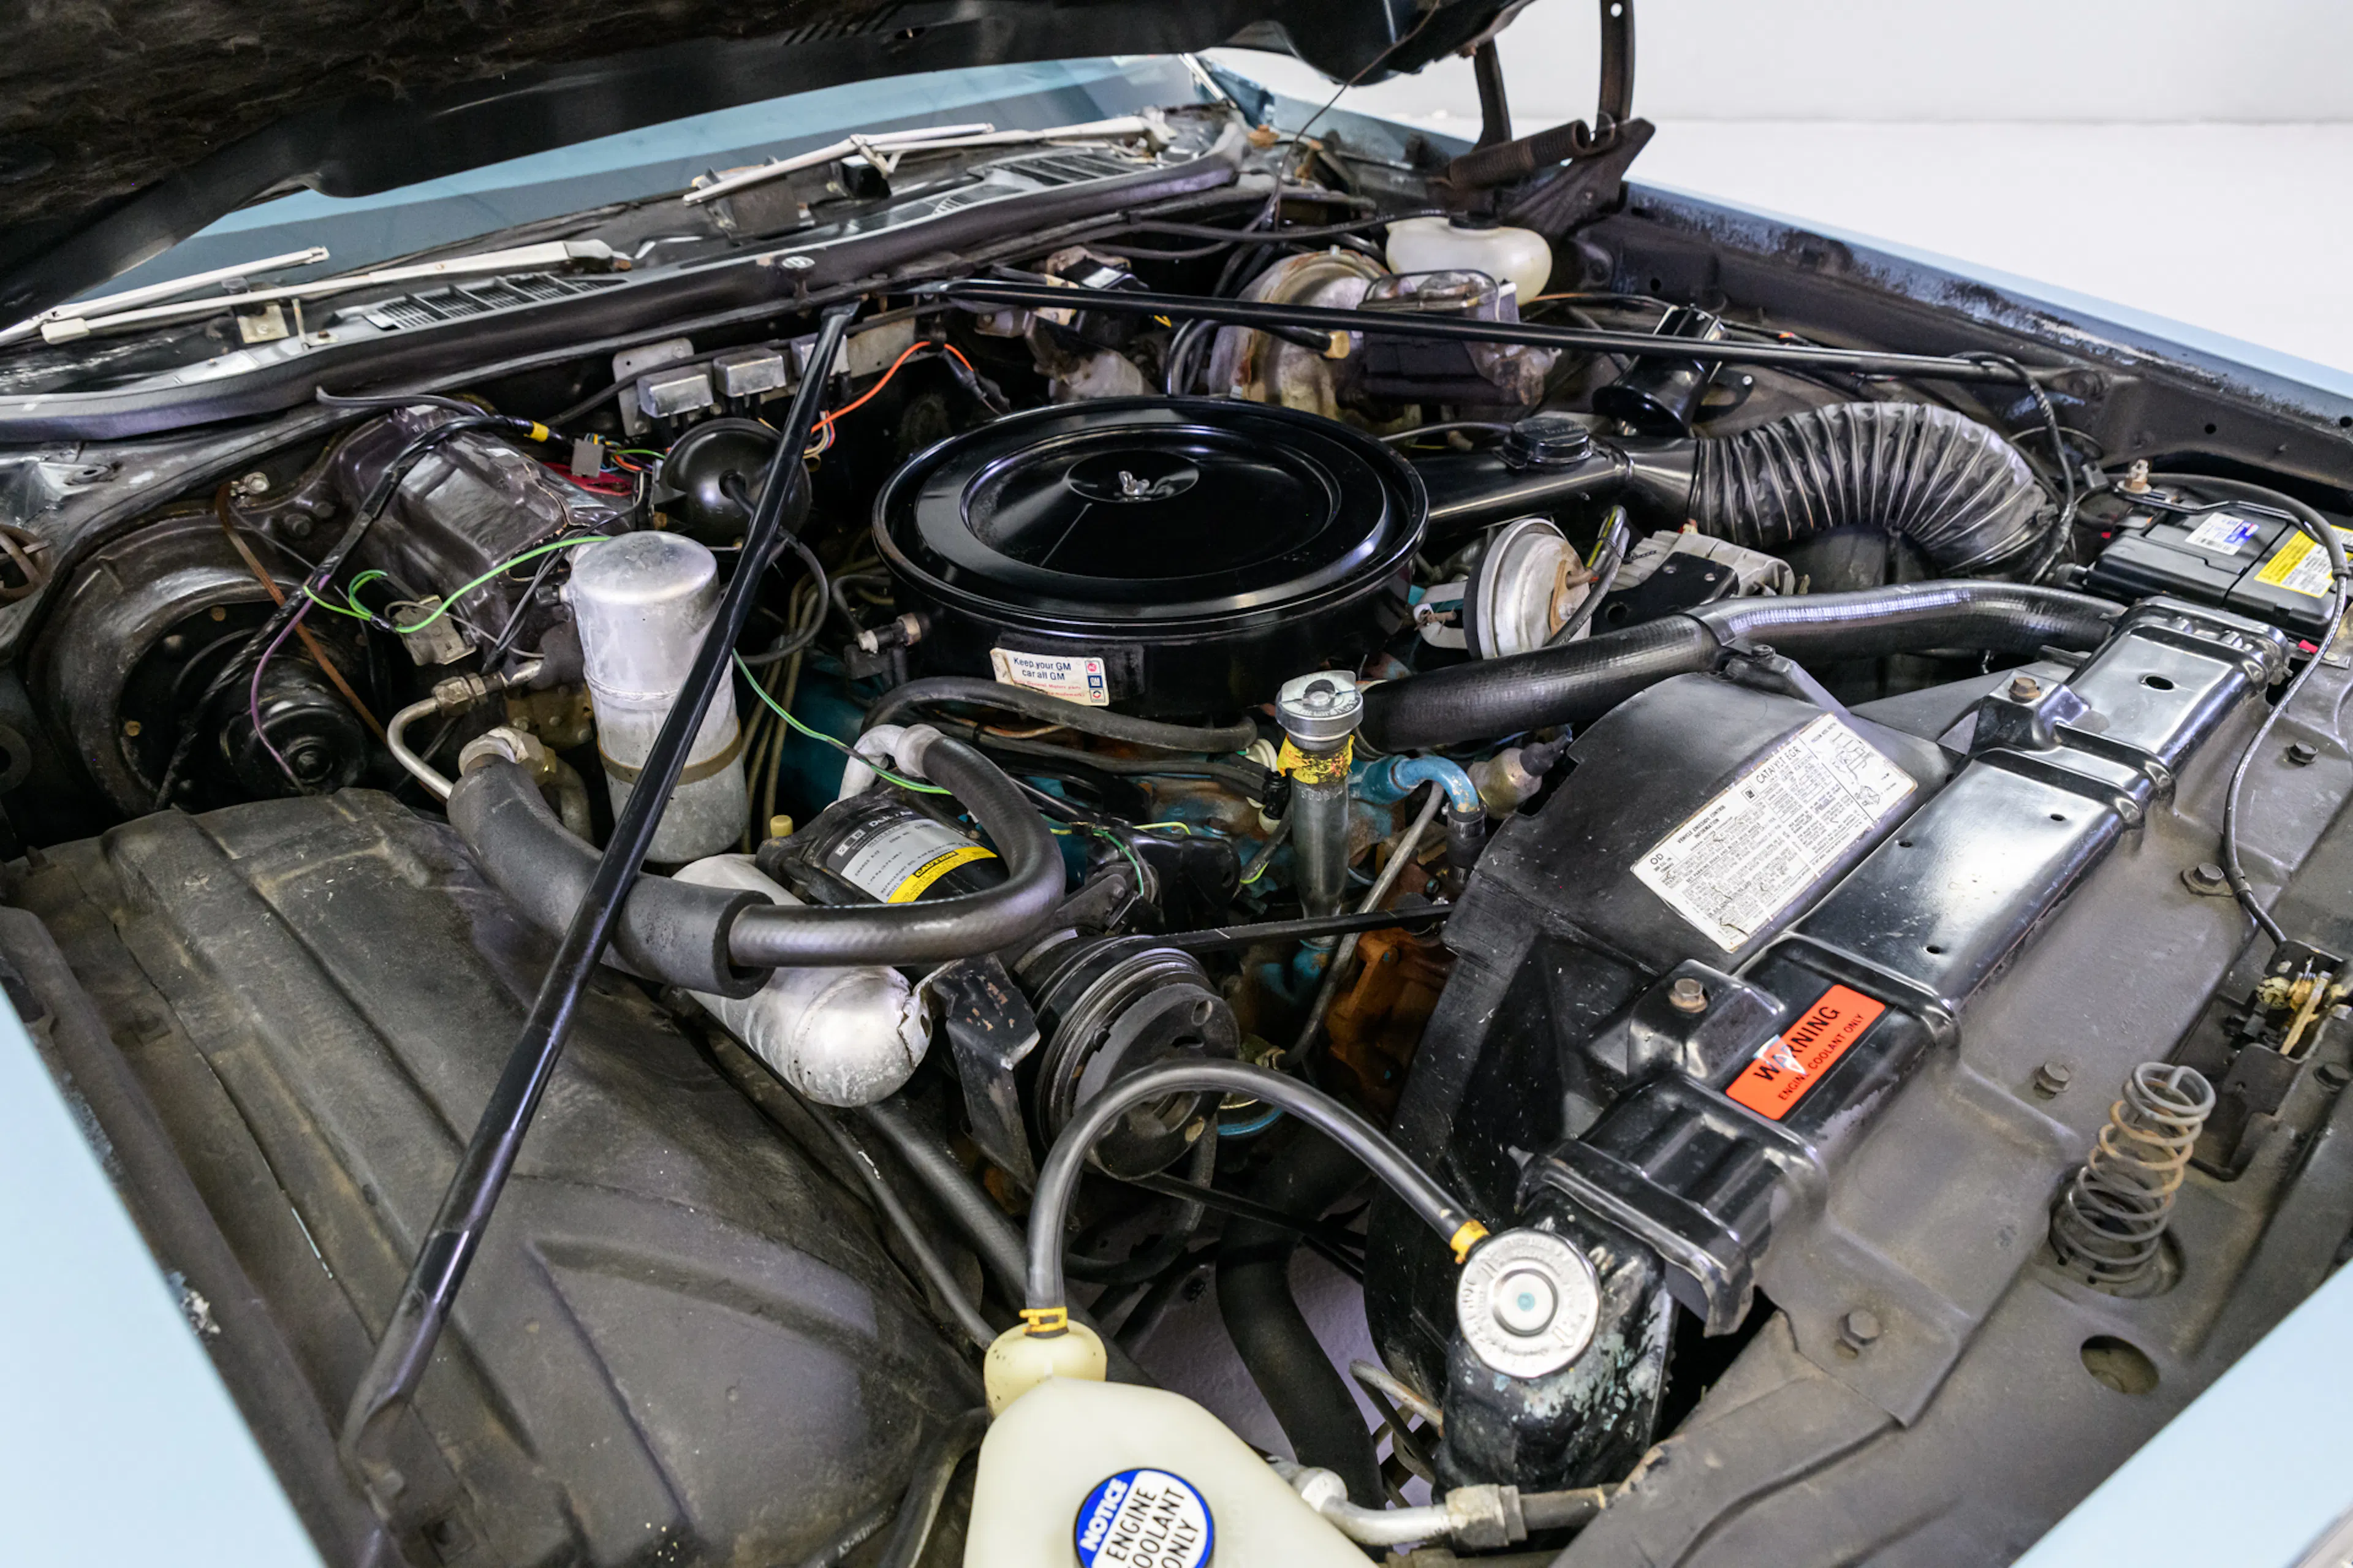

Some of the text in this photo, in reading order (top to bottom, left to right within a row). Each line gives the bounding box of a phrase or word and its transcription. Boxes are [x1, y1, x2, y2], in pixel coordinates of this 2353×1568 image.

[1014, 657, 1034, 668] Keep
[1056, 662, 1072, 670] GM
[915, 850, 955, 877] CAUTION
[1650, 853, 1664, 865] OD
[1753, 1006, 1840, 1081] WARNING
[1808, 1032, 1847, 1070] COOLANT
[1843, 1013, 1865, 1034] ONLY
[1080, 1477, 1129, 1552] NOTICE
[1105, 1487, 1158, 1562] ENGINE
[1126, 1487, 1185, 1568] OOLANT
[1161, 1518, 1199, 1568] ONLY
